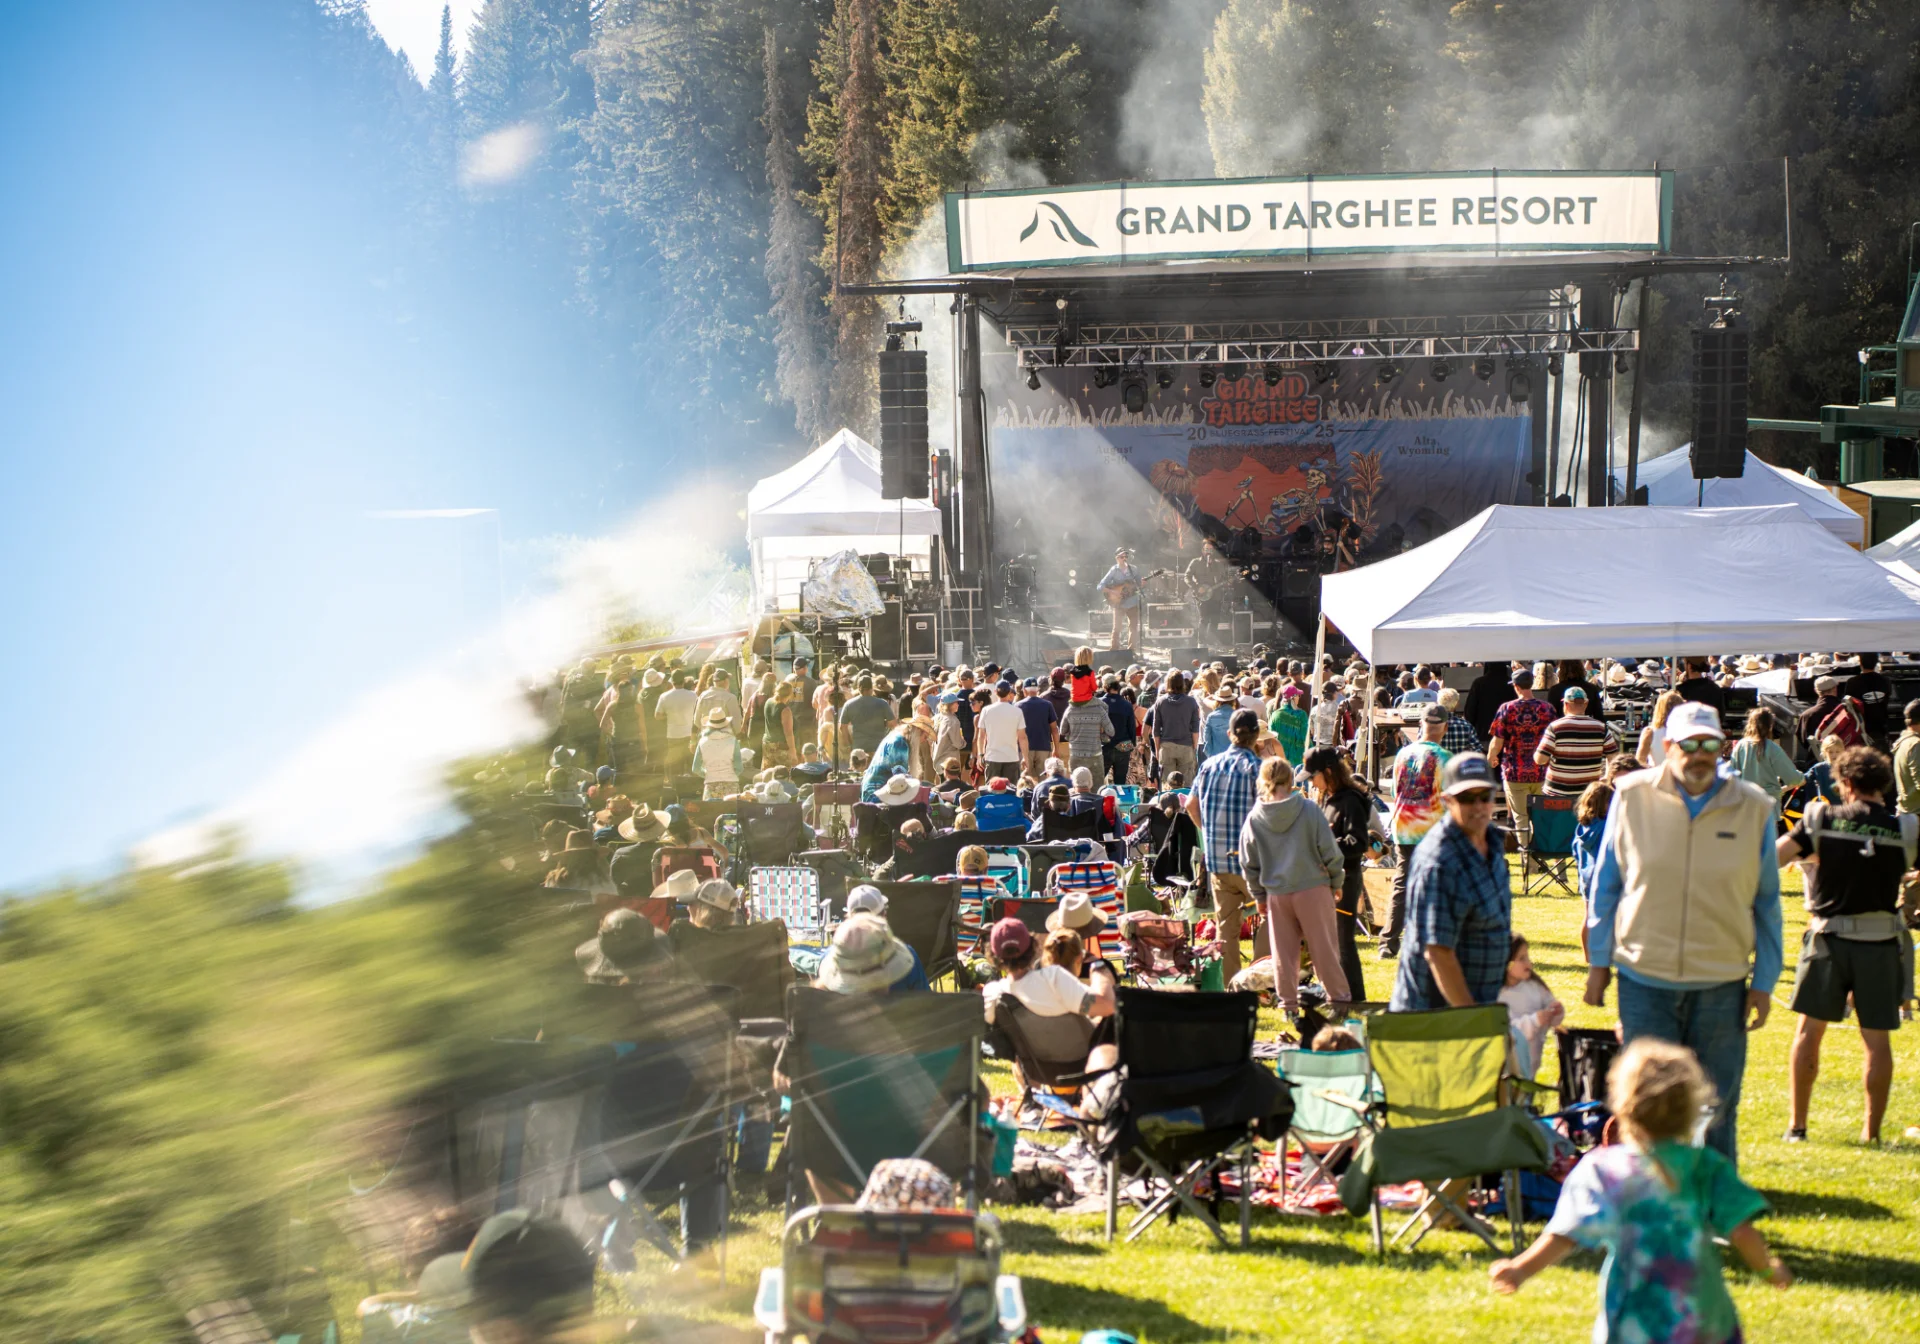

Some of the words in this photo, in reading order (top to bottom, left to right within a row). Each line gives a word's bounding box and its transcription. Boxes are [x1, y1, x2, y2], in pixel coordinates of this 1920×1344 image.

[1116, 204, 1251, 235] GRAND
[1263, 198, 1437, 230] TARGHEE
[1452, 196, 1597, 225] RESORT
[1216, 376, 1305, 401] GRAND
[1203, 399, 1319, 425] TARGHEE
[1187, 427, 1207, 441] 20
[1209, 429, 1265, 438] BLUEGRASS
[1268, 428, 1310, 437] FESTIVAL
[1315, 424, 1335, 438] 25
[1397, 445, 1450, 457] Wyoming
